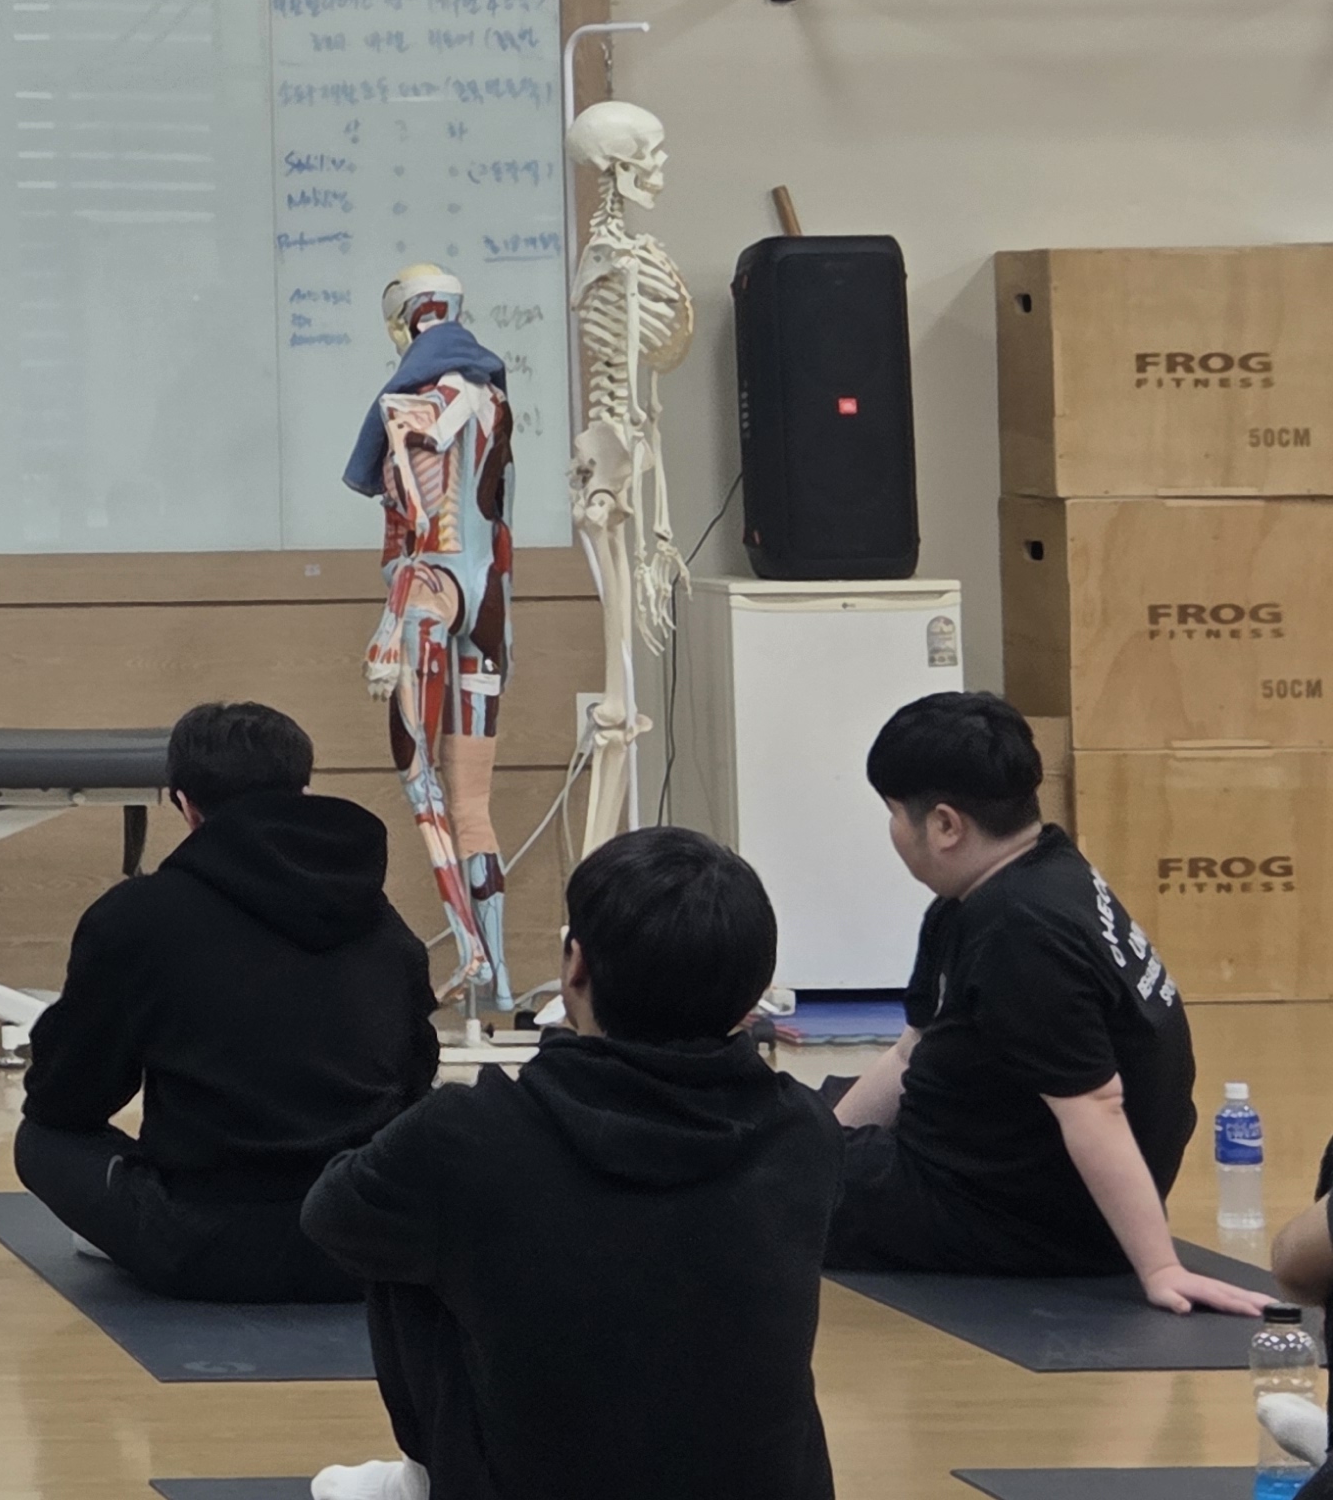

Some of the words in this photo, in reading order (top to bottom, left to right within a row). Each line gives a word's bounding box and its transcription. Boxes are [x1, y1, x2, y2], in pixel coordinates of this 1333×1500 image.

[1134, 351, 1274, 375] FROG
[1134, 376, 1275, 389] FITNESS
[1248, 427, 1311, 448] 50CM
[1146, 602, 1284, 626] FROG
[1147, 627, 1285, 641] FITNESS
[1260, 678, 1324, 700] 50CM
[1157, 856, 1294, 880] FROG
[1157, 881, 1295, 895] FITNESS
